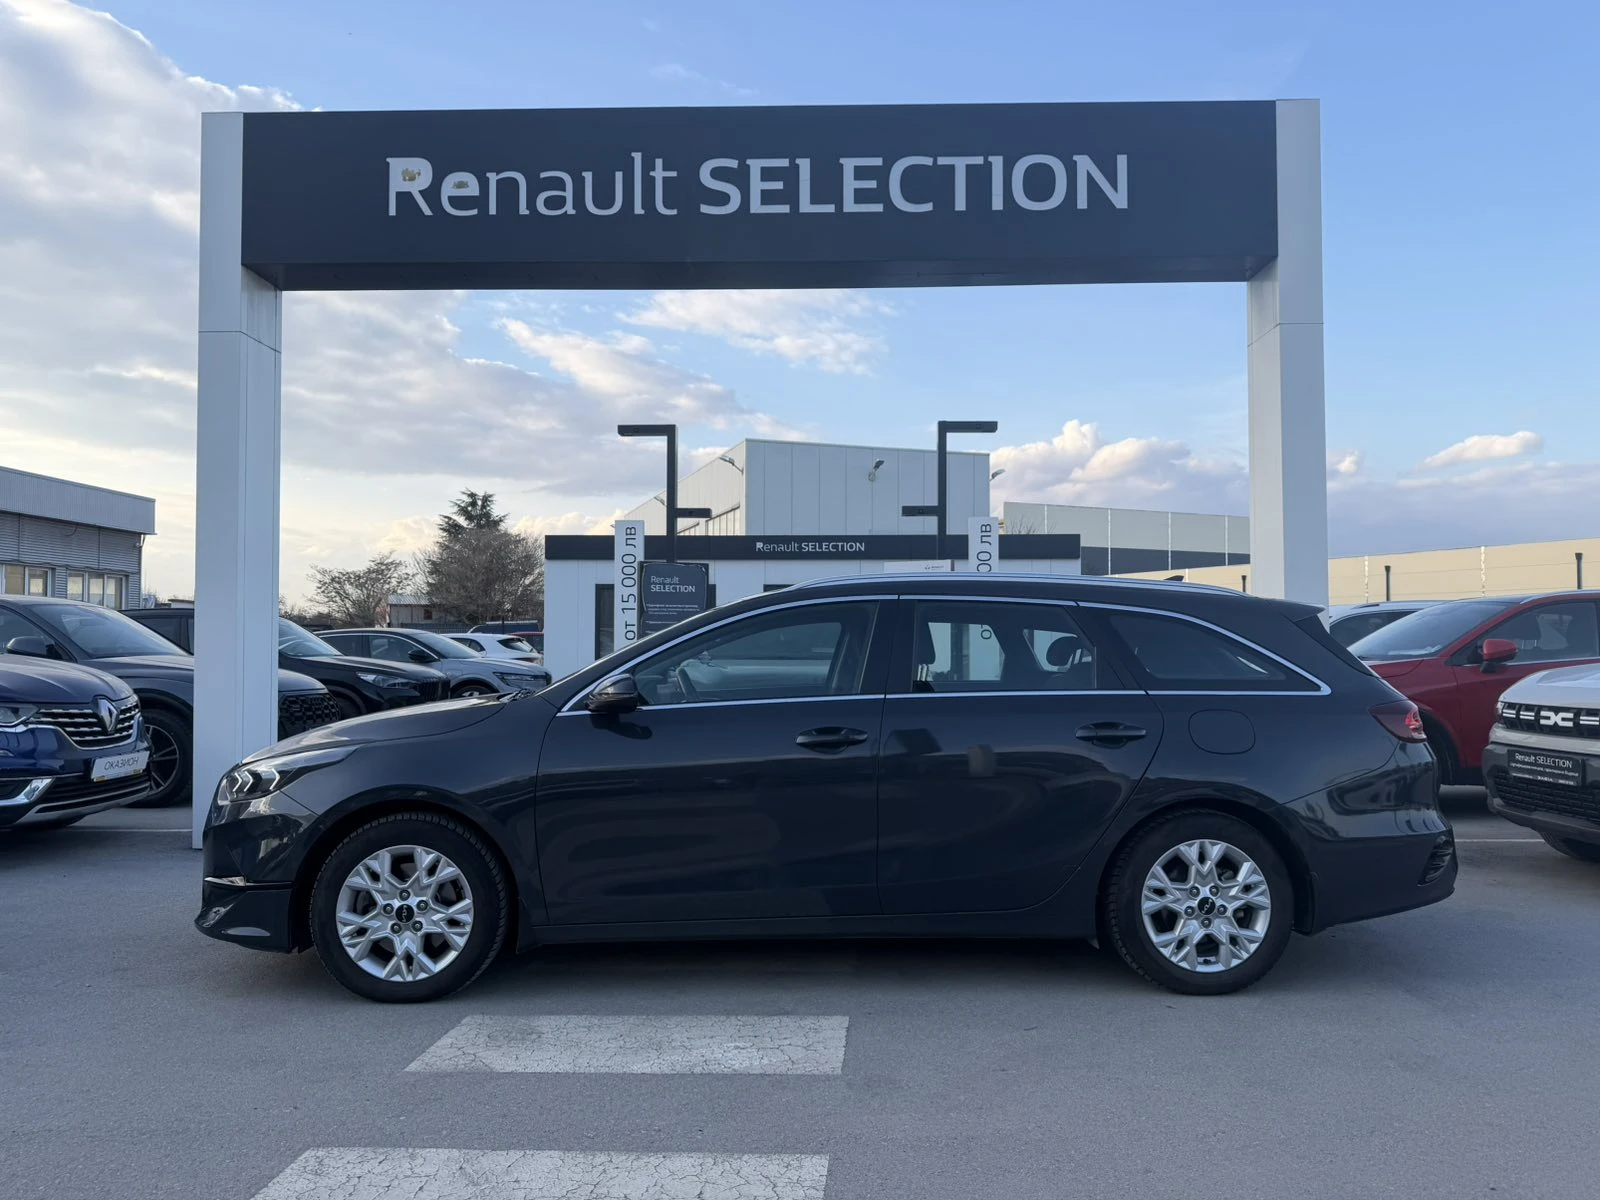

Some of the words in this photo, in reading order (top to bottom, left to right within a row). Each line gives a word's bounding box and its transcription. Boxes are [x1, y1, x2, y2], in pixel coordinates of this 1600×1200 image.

[386, 152, 678, 217] Renault
[698, 153, 1129, 215] SELECTION
[624, 526, 637, 548] лв
[980, 524, 992, 546] лв
[755, 541, 799, 552] Renault
[801, 541, 866, 552] SELECTION
[621, 553, 637, 588] 000
[976, 551, 992, 573] 00
[650, 575, 680, 584] Renault
[650, 584, 696, 593] SELECTION
[621, 593, 637, 614] 15
[624, 620, 636, 641] от
[103, 756, 140, 771] ОКАЗИОН
[1515, 752, 1536, 764] Renault
[1536, 755, 1573, 769] SELECTION
